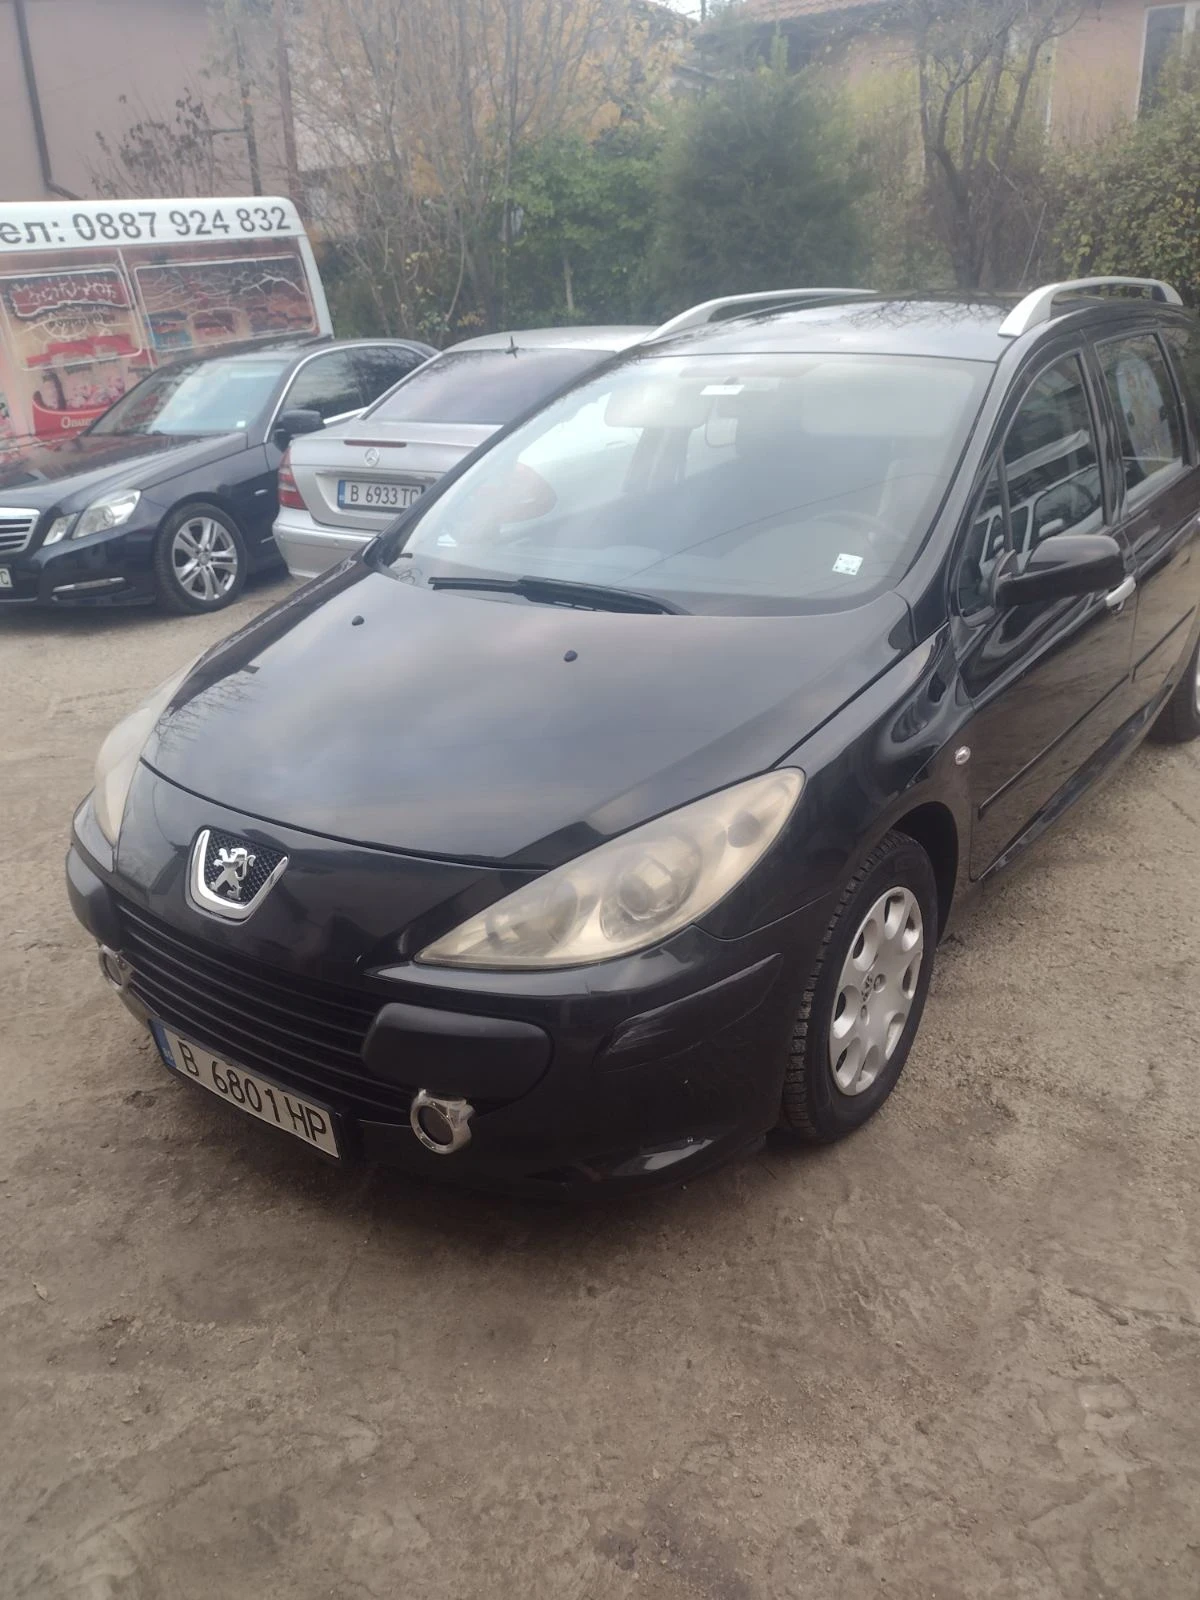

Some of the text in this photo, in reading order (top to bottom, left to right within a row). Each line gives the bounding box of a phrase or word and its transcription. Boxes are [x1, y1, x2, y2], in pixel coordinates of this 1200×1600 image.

[72, 211, 157, 241] 0887
[169, 209, 230, 235] 924
[236, 206, 291, 232] 832
[350, 485, 359, 502] B
[365, 485, 398, 505] 6933
[178, 1040, 327, 1142] B 6801 HP
